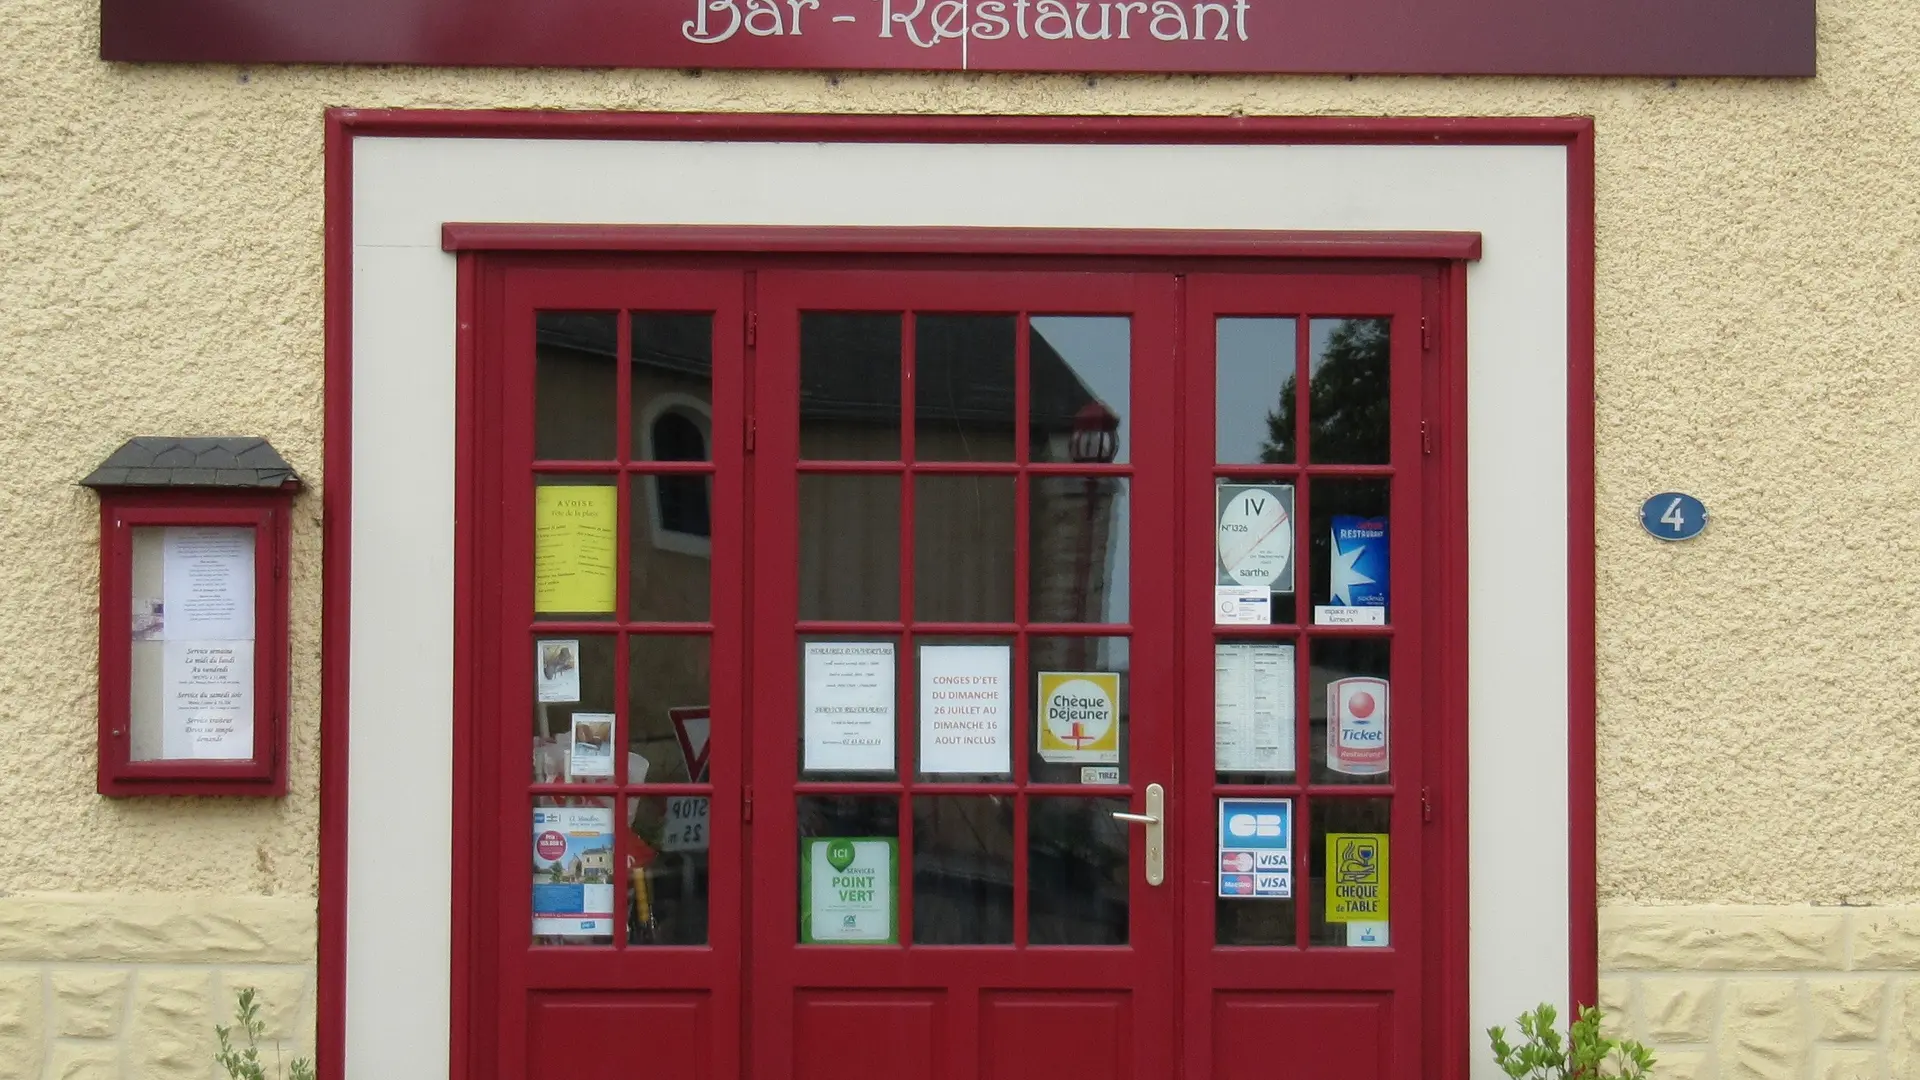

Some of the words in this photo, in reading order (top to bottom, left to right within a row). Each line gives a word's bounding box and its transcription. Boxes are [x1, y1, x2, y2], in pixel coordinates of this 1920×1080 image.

[682, 0, 820, 44] Bar
[878, 0, 1250, 48] Restaurant
[1244, 498, 1265, 516] IV
[1660, 497, 1685, 531] 4
[1340, 528, 1384, 539] RESTAURANT
[1239, 568, 1269, 577] sarthe
[1324, 608, 1345, 616] espace
[933, 676, 970, 685] CONGES
[973, 676, 998, 685] D'ETE
[177, 691, 199, 699] Service
[932, 691, 946, 700] DU
[949, 691, 999, 700] DIMANCHE
[1053, 694, 1105, 709] Chèque
[934, 706, 945, 715] 26
[948, 706, 980, 715] JUILLET
[983, 706, 997, 715] AU
[1049, 707, 1109, 722] Déjeuner
[934, 721, 984, 730] DIMANCHE
[987, 721, 998, 730] 16
[1342, 728, 1383, 741] Ticket
[935, 736, 961, 745] AOUT
[963, 736, 996, 745] INCLUS
[1340, 749, 1384, 758] Restaurant
[1098, 771, 1118, 780] TIREZ
[1229, 813, 1281, 837] CB
[833, 848, 848, 858] ICI
[1260, 854, 1287, 866] VISA
[832, 876, 875, 888] POINT
[1260, 877, 1287, 888] VISA
[838, 889, 875, 902] VERT
[1336, 885, 1378, 900] CHEQUE
[1336, 903, 1345, 913] de
[1345, 899, 1379, 913] TABLE
